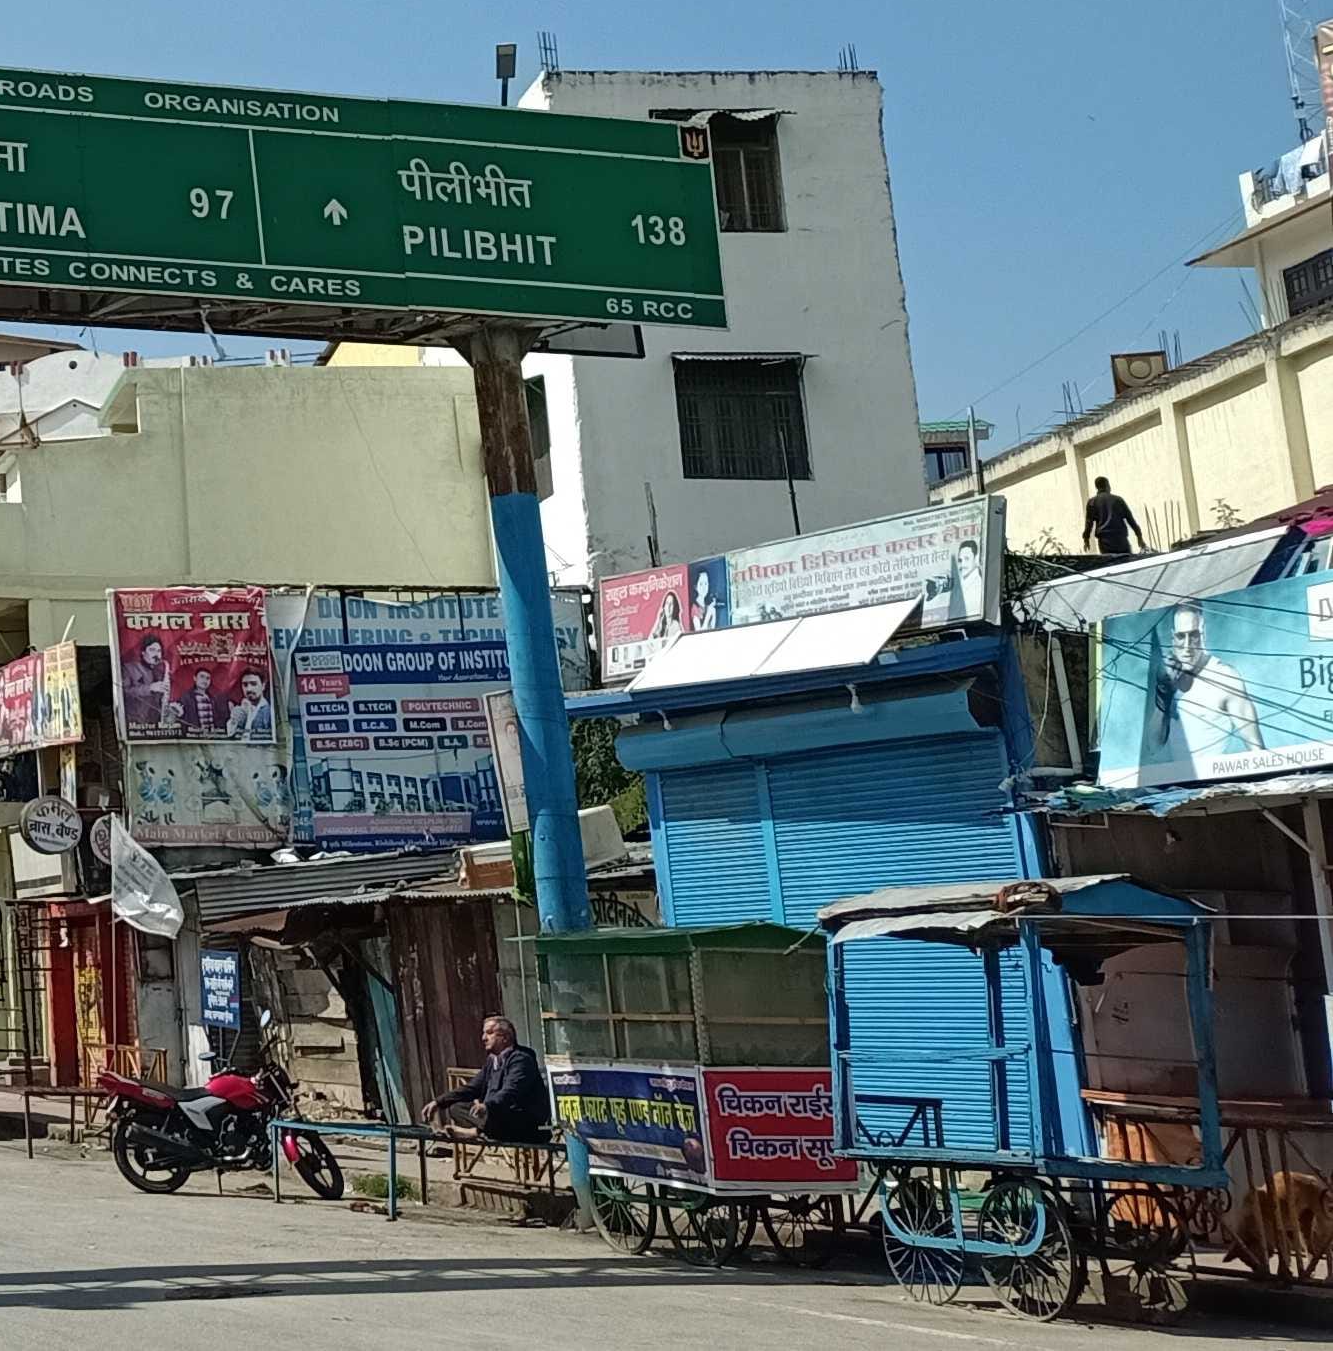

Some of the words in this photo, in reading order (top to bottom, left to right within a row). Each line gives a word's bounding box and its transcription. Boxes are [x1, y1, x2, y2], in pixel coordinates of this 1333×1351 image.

[143, 91, 340, 123] ORGANISATION
[396, 157, 533, 209] पीलीभीत
[189, 187, 234, 220] 97
[402, 224, 557, 267] PILIBHIT
[630, 213, 687, 246] 138
[68, 261, 218, 288] CONNECTS
[235, 272, 254, 290] &
[269, 275, 361, 297] CARES
[605, 297, 634, 315] 65
[642, 300, 693, 319] RCC
[800, 542, 878, 572] डिजिटल
[885, 532, 937, 553] कलर
[122, 611, 193, 631] कमल
[198, 611, 251, 632] ब्रास
[272, 626, 415, 650] ENGINERING
[342, 651, 384, 673] DOON
[386, 650, 434, 672] GROUP
[438, 649, 456, 670] OF
[300, 677, 317, 692] 14
[319, 678, 343, 689] Years
[359, 701, 392, 712] B.TECH
[408, 700, 472, 712] POLYTECHNIC
[409, 720, 441, 730] M.Com
[1212, 756, 1252, 775] PAWAR
[1252, 753, 1285, 770] SALES
[1286, 747, 1326, 767] HOUSE
[36, 801, 76, 823] कमल
[136, 827, 168, 842] Main
[716, 1084, 785, 1117] चिकन
[728, 1127, 801, 1161] चिकन
[802, 1134, 837, 1170] सू
